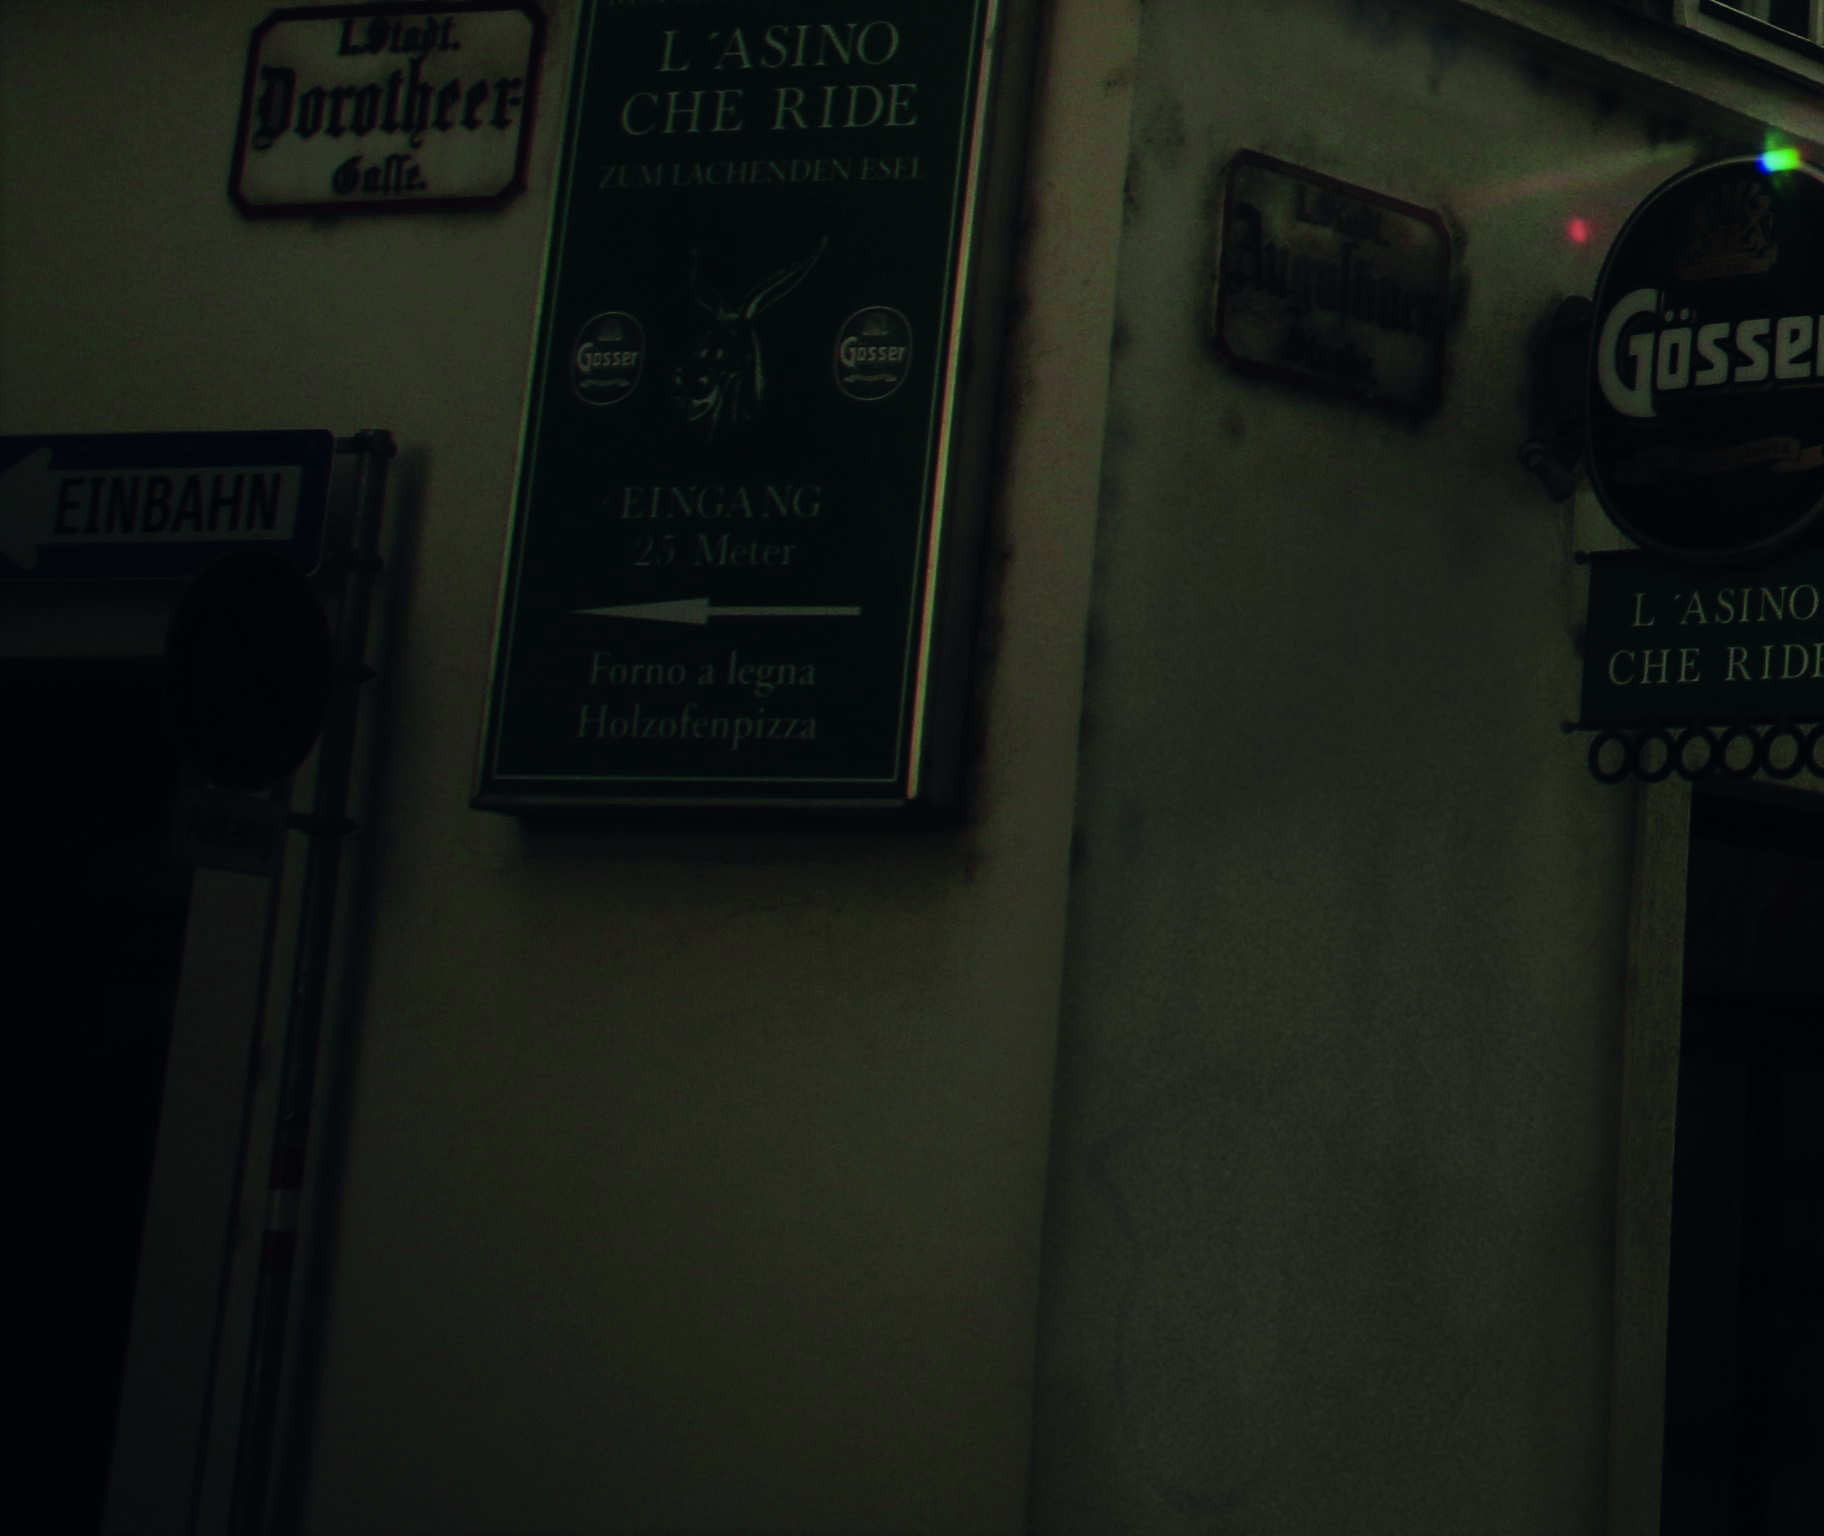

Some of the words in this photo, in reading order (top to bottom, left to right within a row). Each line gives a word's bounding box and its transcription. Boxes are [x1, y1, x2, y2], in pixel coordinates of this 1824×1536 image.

[621, 89, 744, 136] CHE
[770, 82, 918, 130] RIDE
[598, 165, 663, 189] ZUM
[671, 157, 851, 186] LACHENDEN
[860, 155, 926, 181] ESEL
[53, 472, 282, 535] EINBAHN
[620, 484, 822, 520] EINGANG
[634, 534, 675, 567] 25
[694, 533, 797, 567] Meter
[589, 651, 687, 685] Forno
[698, 665, 715, 686] a
[727, 650, 816, 698] legna
[1608, 648, 1701, 685] CHE
[576, 703, 817, 751] Holzofenpizza
[187, 806, 273, 861] Anfang
